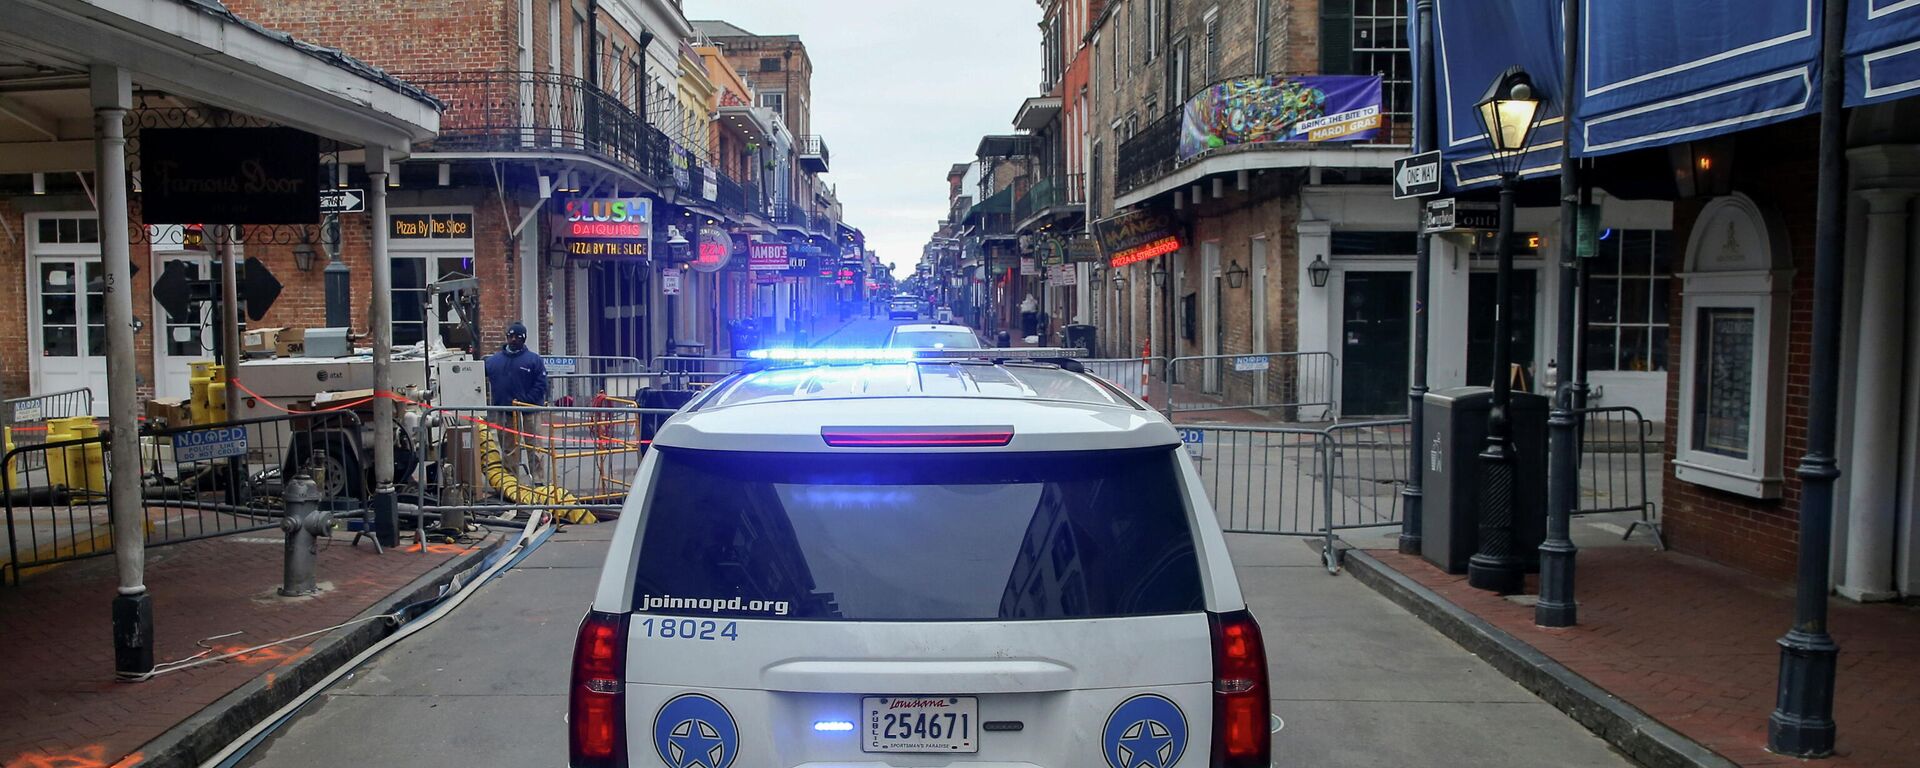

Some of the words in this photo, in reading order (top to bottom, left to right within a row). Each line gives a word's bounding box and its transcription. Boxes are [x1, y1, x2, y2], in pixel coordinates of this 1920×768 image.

[1301, 118, 1326, 130] BRING
[1329, 114, 1343, 123] THE
[1345, 111, 1360, 120] BITE
[1363, 107, 1374, 116] TO
[1312, 125, 1345, 139] MARDI
[1350, 117, 1376, 131] GRAS
[1407, 168, 1420, 184] ONE
[1422, 166, 1436, 183] WAY
[566, 201, 647, 222] SLUSH
[1428, 210, 1454, 226] Bourbon
[396, 220, 416, 235] Pizza
[418, 220, 429, 237] By
[431, 219, 445, 233] The
[573, 224, 640, 236] DAIQUIRIS
[1105, 214, 1169, 245] MANGO
[593, 242, 605, 255] BY
[606, 242, 622, 255] THE
[624, 243, 647, 256] SLICE
[1111, 254, 1131, 268] PIZZA
[287, 343, 304, 352] 3M
[188, 445, 214, 453] POLICE
[219, 442, 235, 450] LINE
[639, 594, 789, 615] joinnopd.org
[642, 618, 738, 641] 18024
[889, 698, 950, 710] Louisiana
[884, 713, 968, 739] 254671
